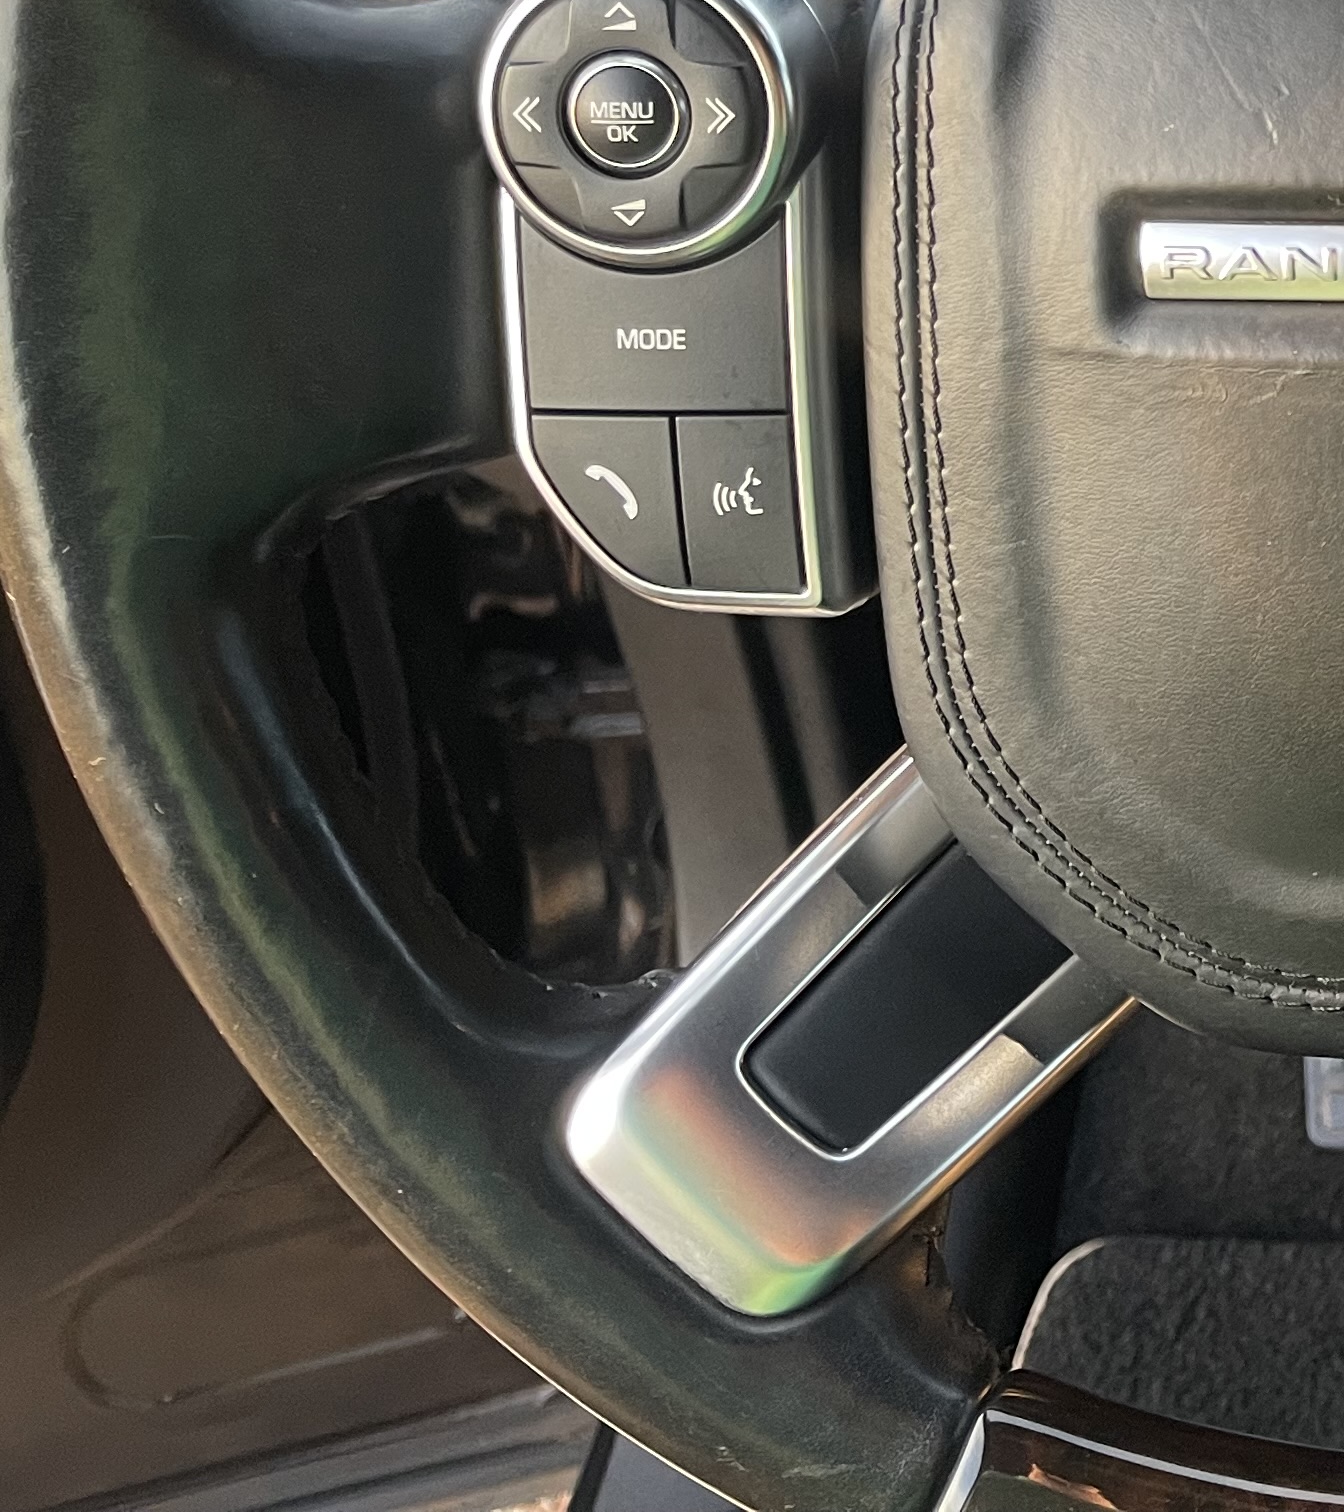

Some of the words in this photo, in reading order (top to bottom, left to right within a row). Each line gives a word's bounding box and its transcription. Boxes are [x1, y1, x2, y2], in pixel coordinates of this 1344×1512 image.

[590, 101, 654, 120] MENU
[607, 124, 639, 143] OK
[617, 329, 686, 350] MODE
